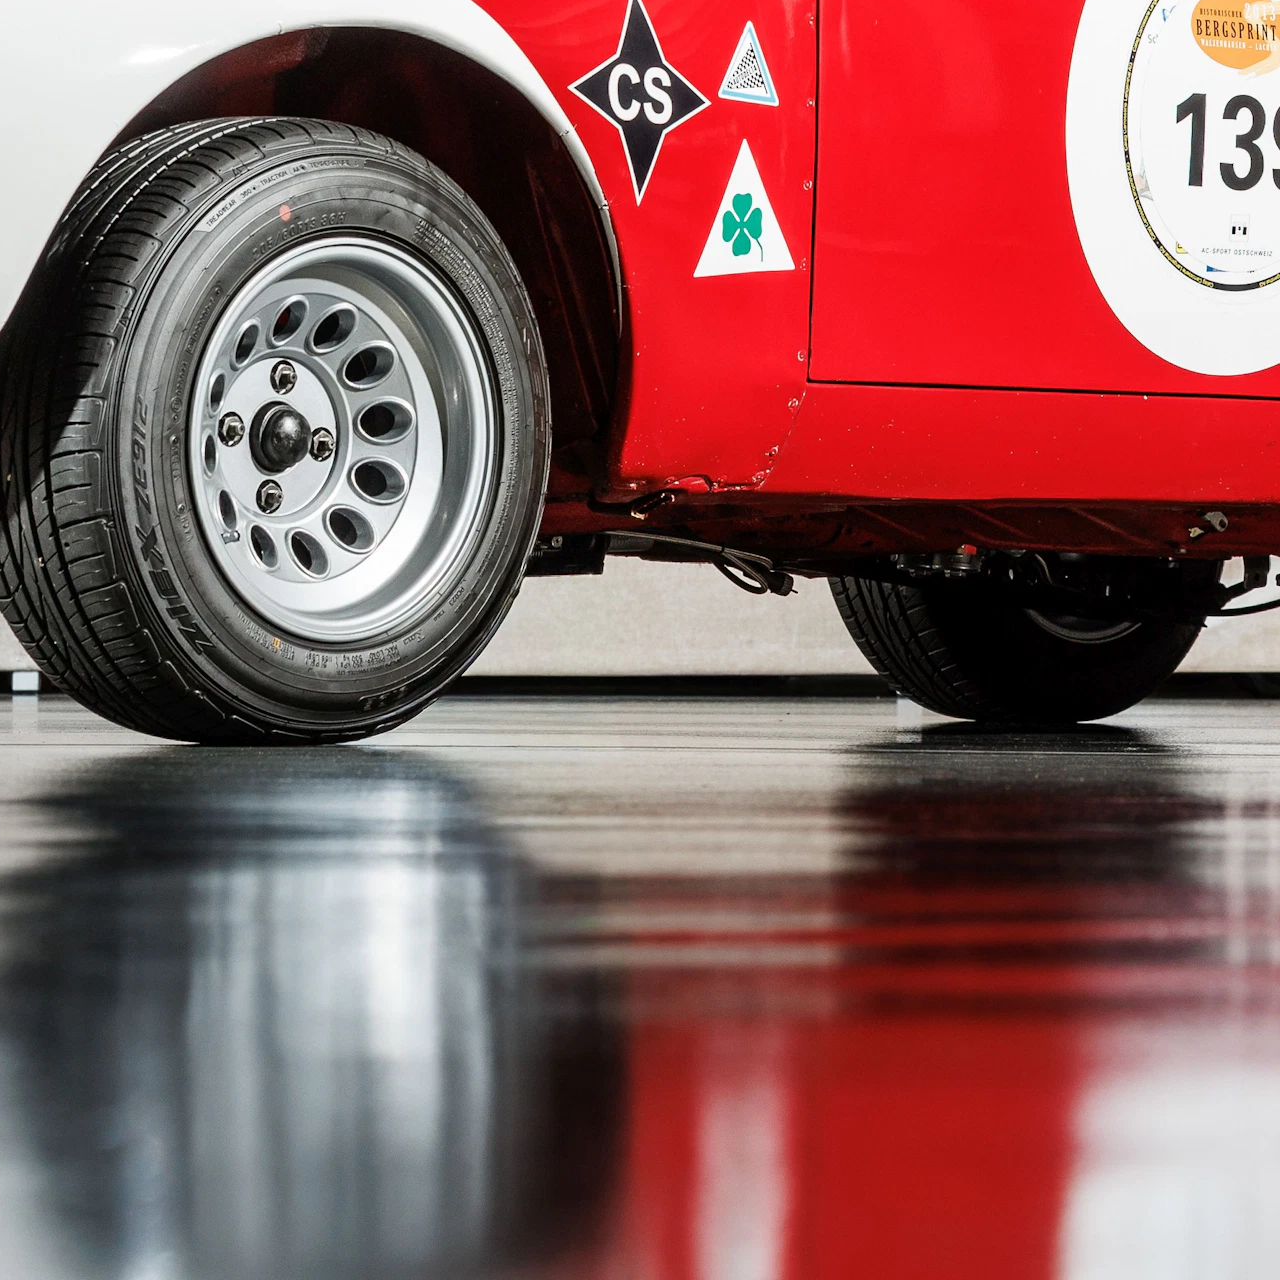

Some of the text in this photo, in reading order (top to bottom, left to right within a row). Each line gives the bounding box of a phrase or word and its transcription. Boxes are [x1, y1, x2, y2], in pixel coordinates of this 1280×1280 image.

[1199, 8, 1242, 18] HISTORISCHER
[1244, 3, 1276, 21] 2013
[1196, 19, 1277, 41] BERGSPRINT
[608, 64, 673, 124] CS
[206, 199, 237, 228] TREADWEAR
[260, 170, 288, 187] TRACTION
[1234, 249, 1273, 257] OSTSCHWEIZ
